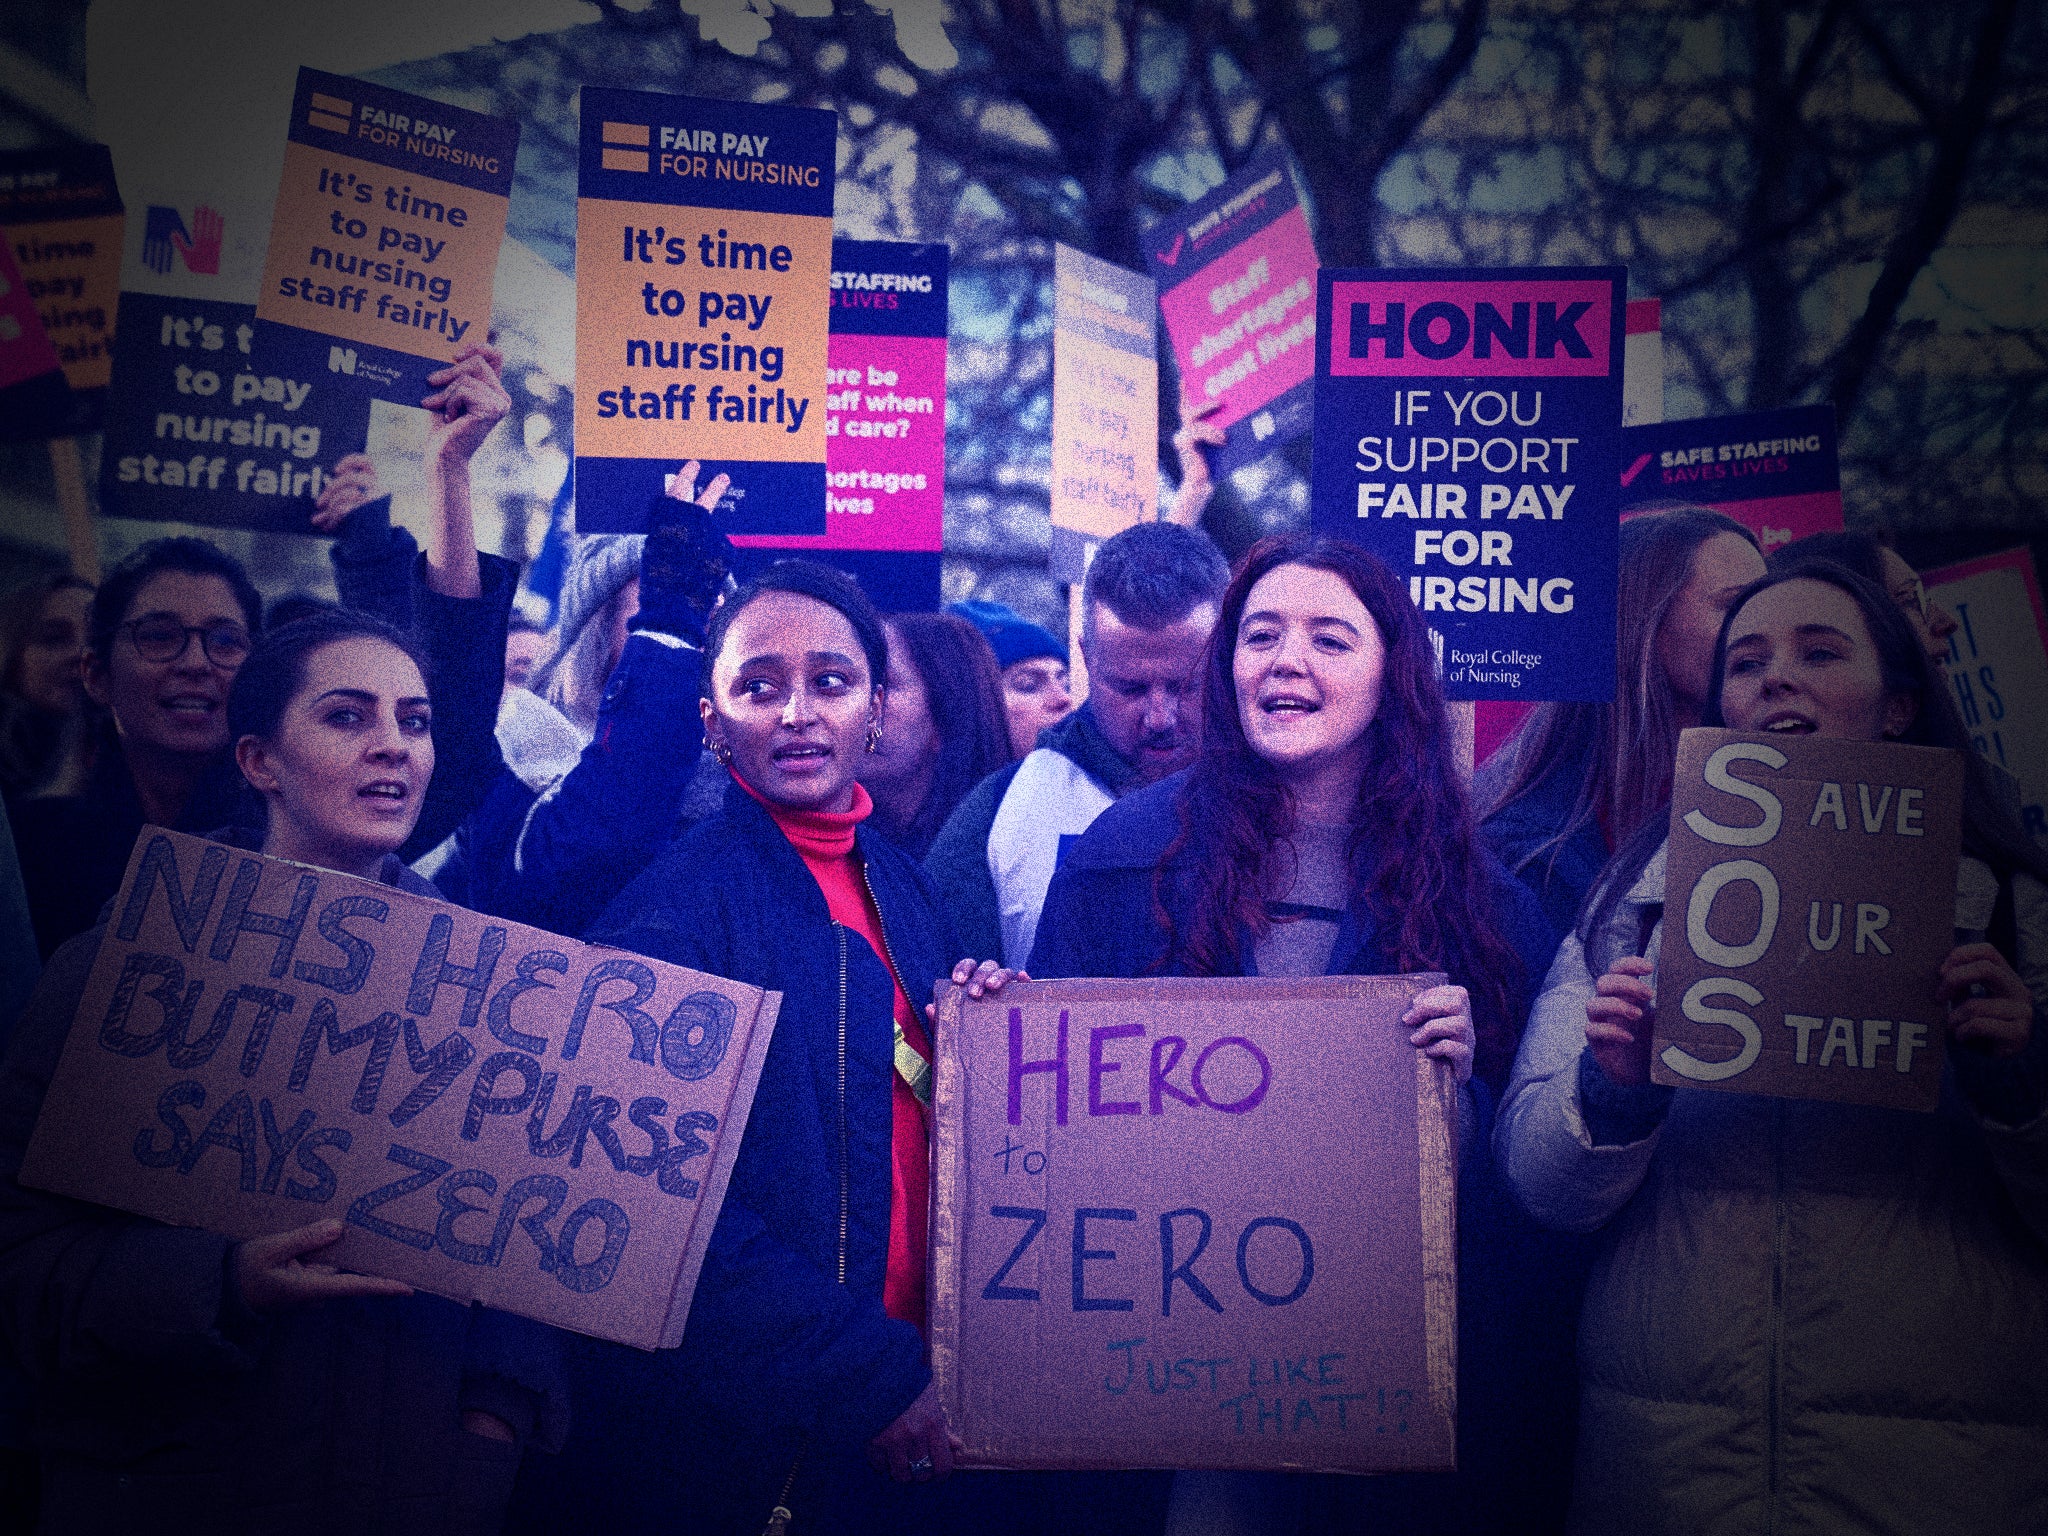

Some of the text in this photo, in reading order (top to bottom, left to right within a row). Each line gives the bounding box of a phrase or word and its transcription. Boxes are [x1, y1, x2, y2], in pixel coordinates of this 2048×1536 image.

[360, 104, 457, 144] FAIR PAY
[660, 127, 770, 158] FAIR PAY
[357, 123, 500, 174] FOR NURSING
[660, 155, 821, 188] FOR NURSING
[384, 186, 468, 228] time
[330, 210, 446, 264] to pay
[623, 227, 792, 272] It's time
[309, 246, 452, 303] nursing
[830, 271, 933, 293] STAFFING
[279, 276, 471, 343] staff fairly
[642, 283, 772, 331] to pay
[842, 291, 899, 310] LIVES
[1349, 301, 1593, 361] HONK
[627, 333, 784, 382] nursing
[867, 364, 899, 387] be
[173, 363, 312, 412] to pay
[826, 389, 935, 414] aff when
[597, 385, 696, 421] staff
[706, 386, 810, 433] fairly
[844, 418, 911, 439] care?
[1394, 391, 1542, 427] IF YOU
[155, 412, 321, 459] nursing
[1355, 437, 1579, 474] SUPPORT
[1660, 434, 1821, 469] SAFE STAFFING
[117, 454, 227, 490] staff
[1661, 456, 1789, 485] SAVES LIVES
[826, 490, 875, 515] ives
[1357, 483, 1576, 520] FAIR PAY
[1414, 530, 1513, 566] FOR
[1450, 667, 1522, 689] of Nursing
[1451, 649, 1543, 671] Royal College
[115, 834, 738, 1081] NHS HERO
[101, 953, 719, 1200] BUT MY PURSE
[1007, 1007, 1272, 1127] HERO
[994, 1134, 1048, 1176] to
[132, 1080, 631, 1294] SAYS ZERO
[981, 1207, 1315, 1317] ZERO
[1104, 1338, 1347, 1395] JUST LIKE
